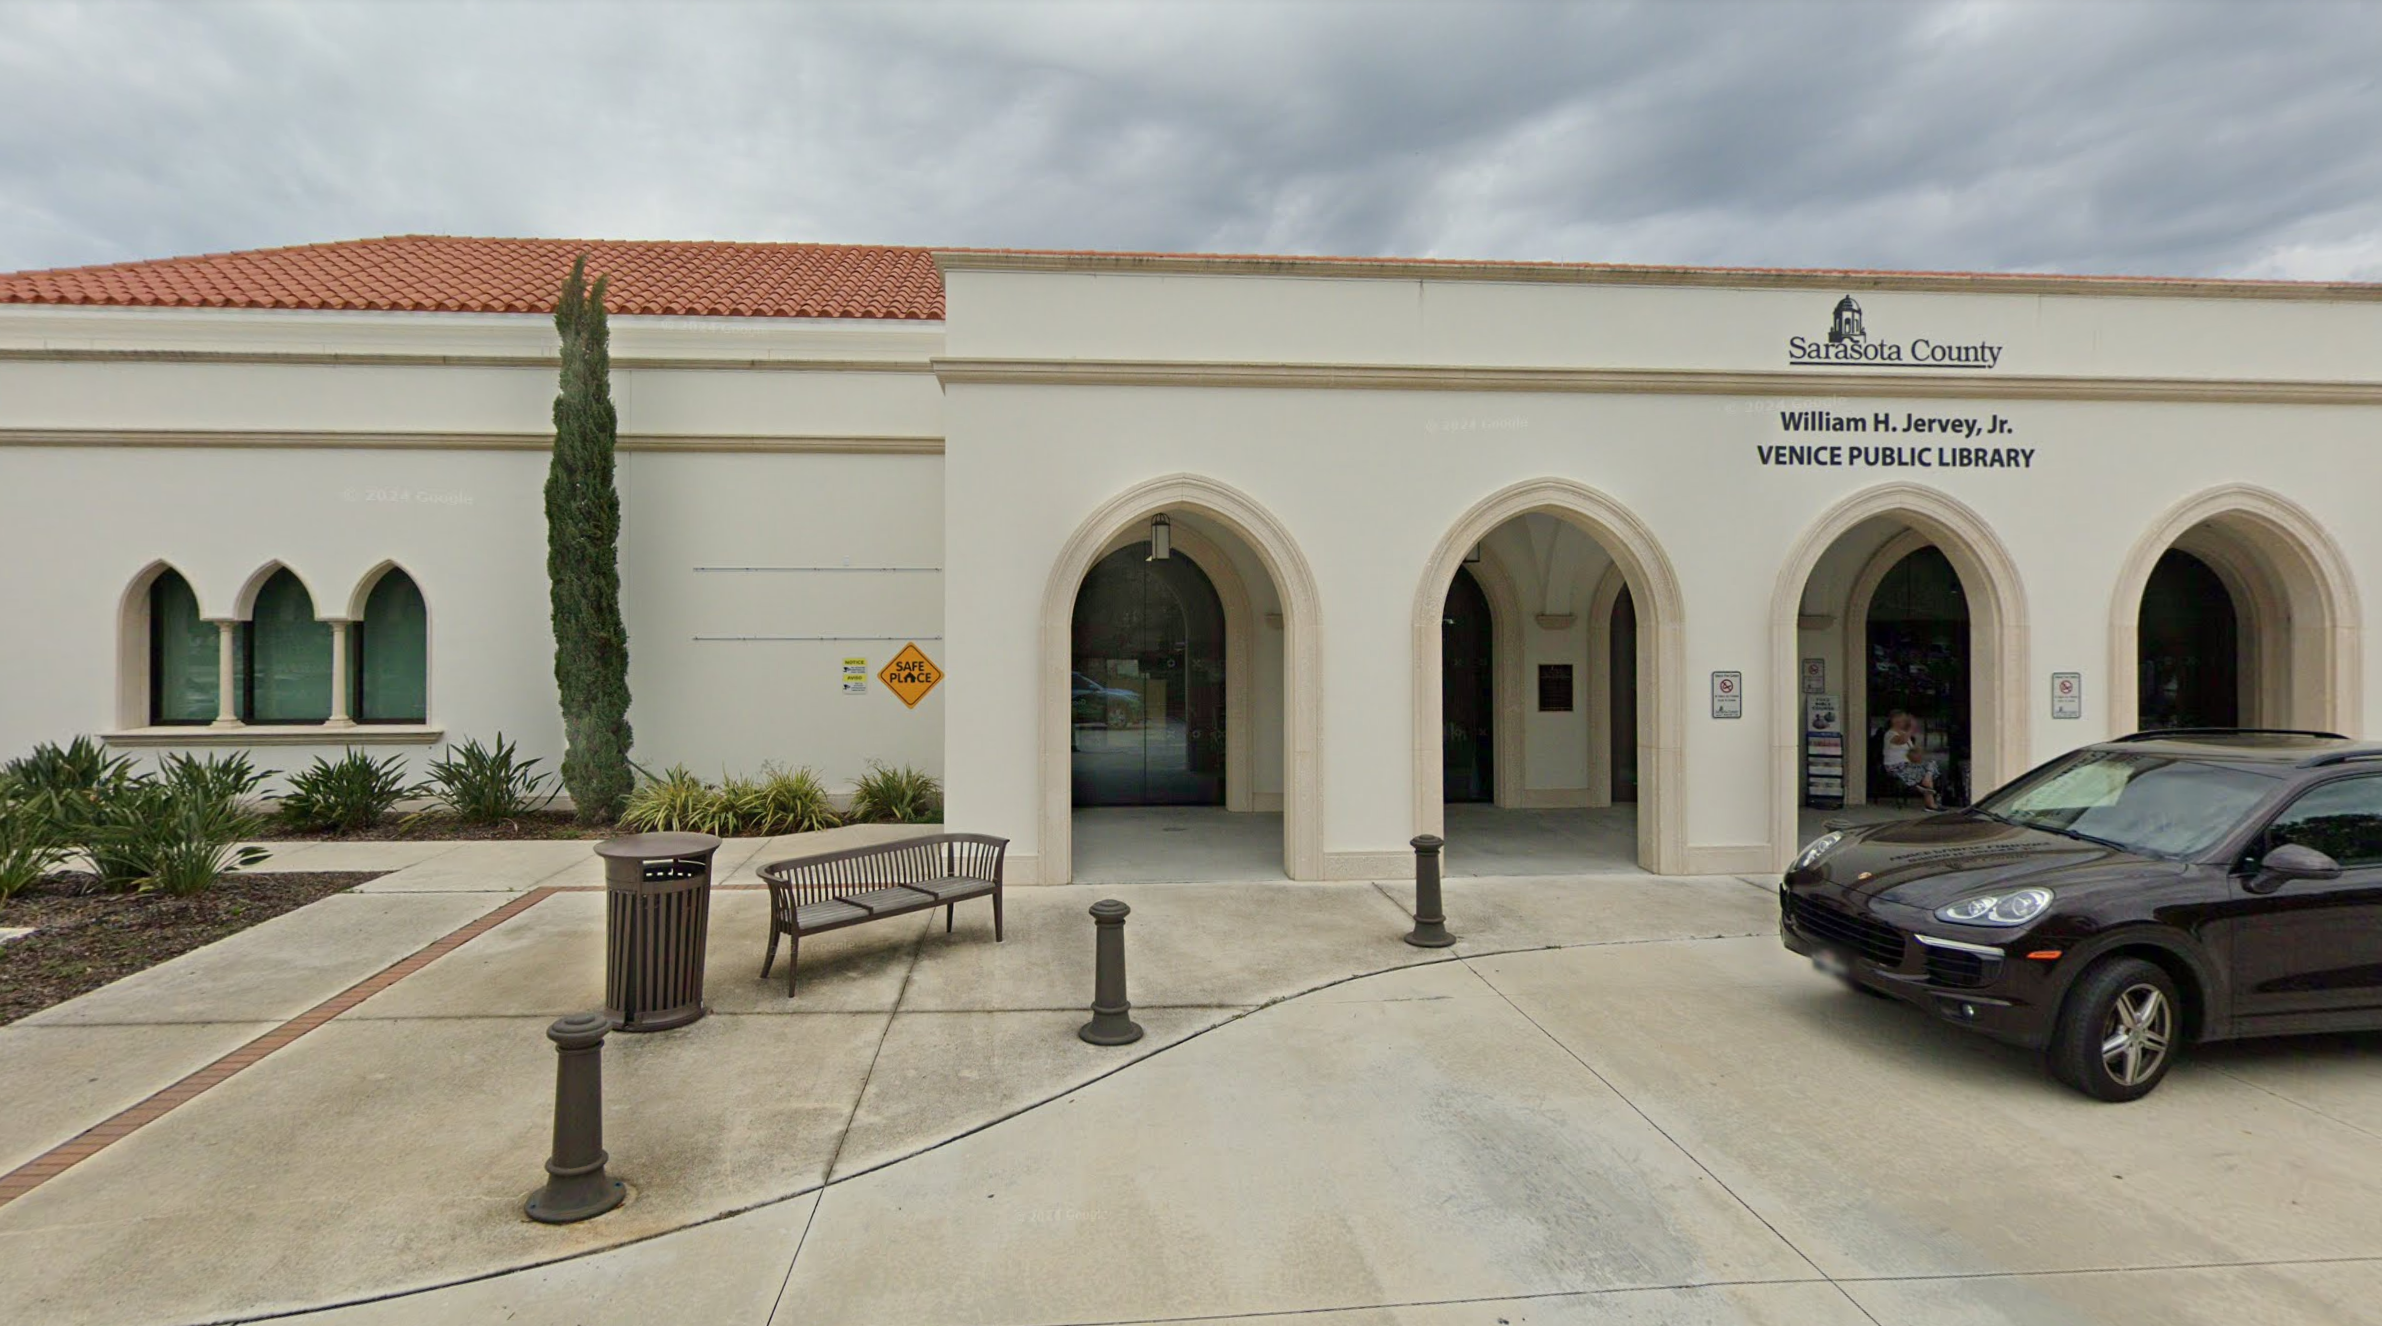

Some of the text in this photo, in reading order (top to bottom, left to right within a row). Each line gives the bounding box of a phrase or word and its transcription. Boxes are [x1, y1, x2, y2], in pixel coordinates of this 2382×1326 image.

[1788, 336, 2004, 369] Sarasota County
[1780, 411, 2014, 439] William H. Jervey, Jr.
[1757, 445, 2036, 469] VENICE PUBLIC LIBRARY
[896, 661, 924, 671] SAFE
